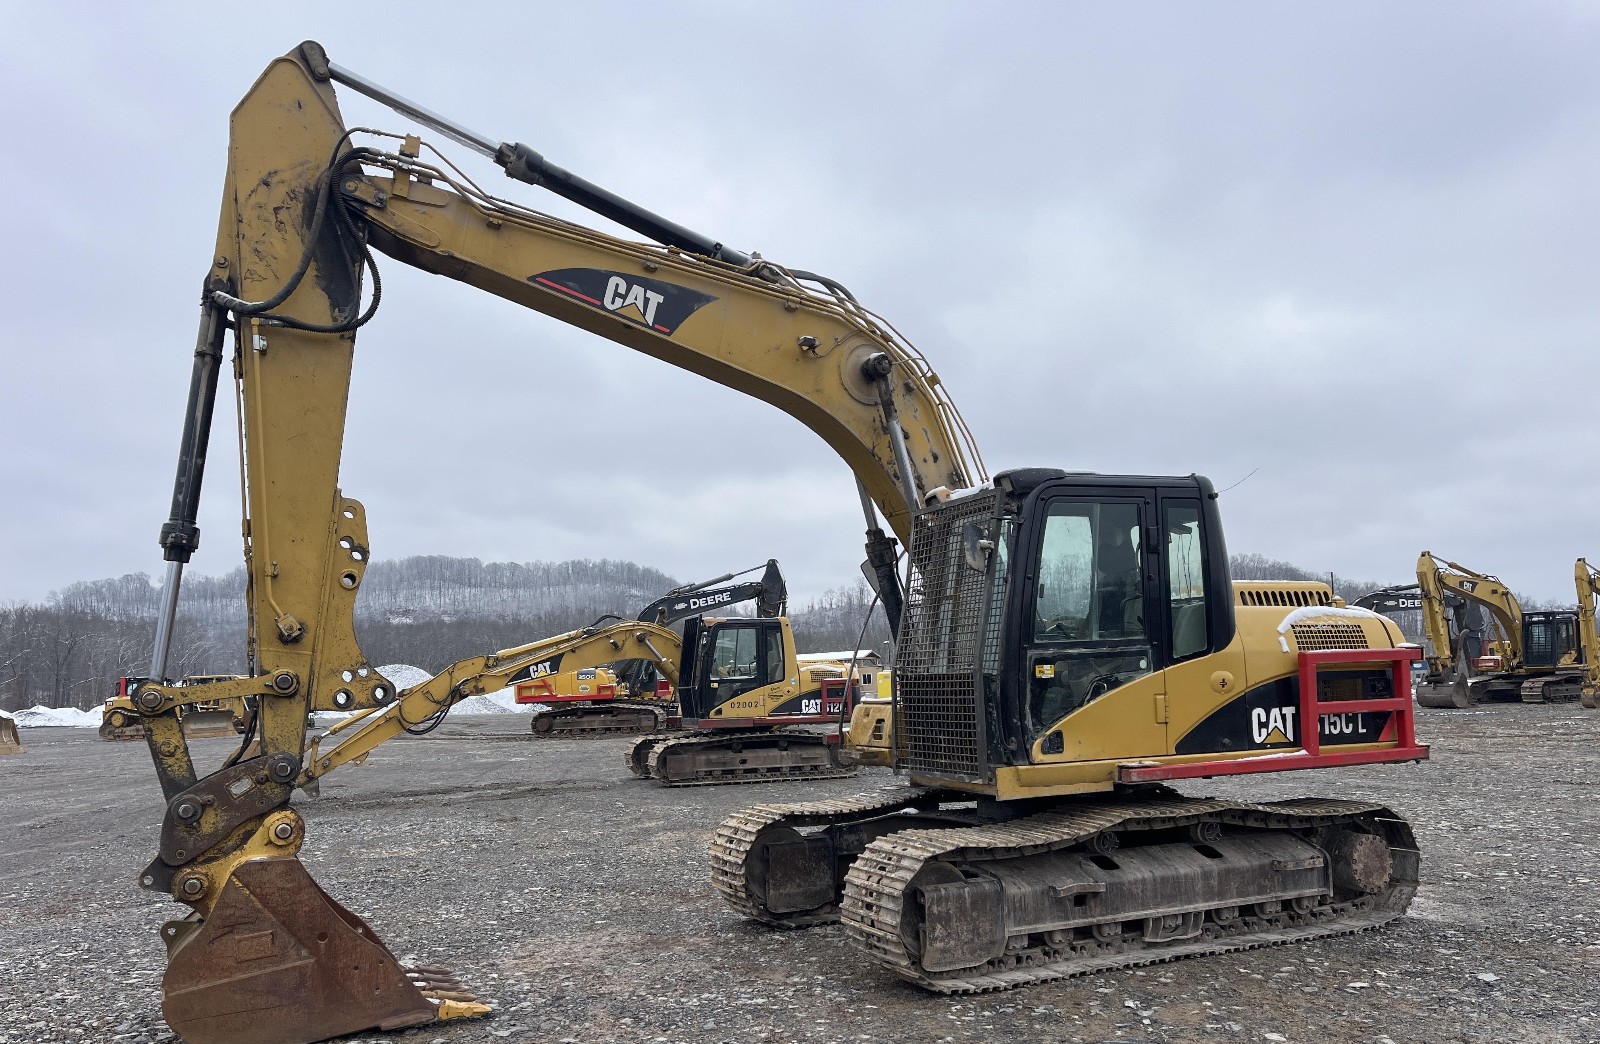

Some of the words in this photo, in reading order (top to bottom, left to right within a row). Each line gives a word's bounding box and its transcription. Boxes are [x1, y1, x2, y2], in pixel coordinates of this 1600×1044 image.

[603, 275, 664, 327] CAT
[690, 591, 732, 609] DEERE
[1399, 598, 1424, 608] DEE
[530, 661, 551, 679] CAT
[801, 699, 823, 714] CAT
[1252, 706, 1296, 744] CAT
[1317, 713, 1353, 735] 15C
[1357, 713, 1367, 734] L
